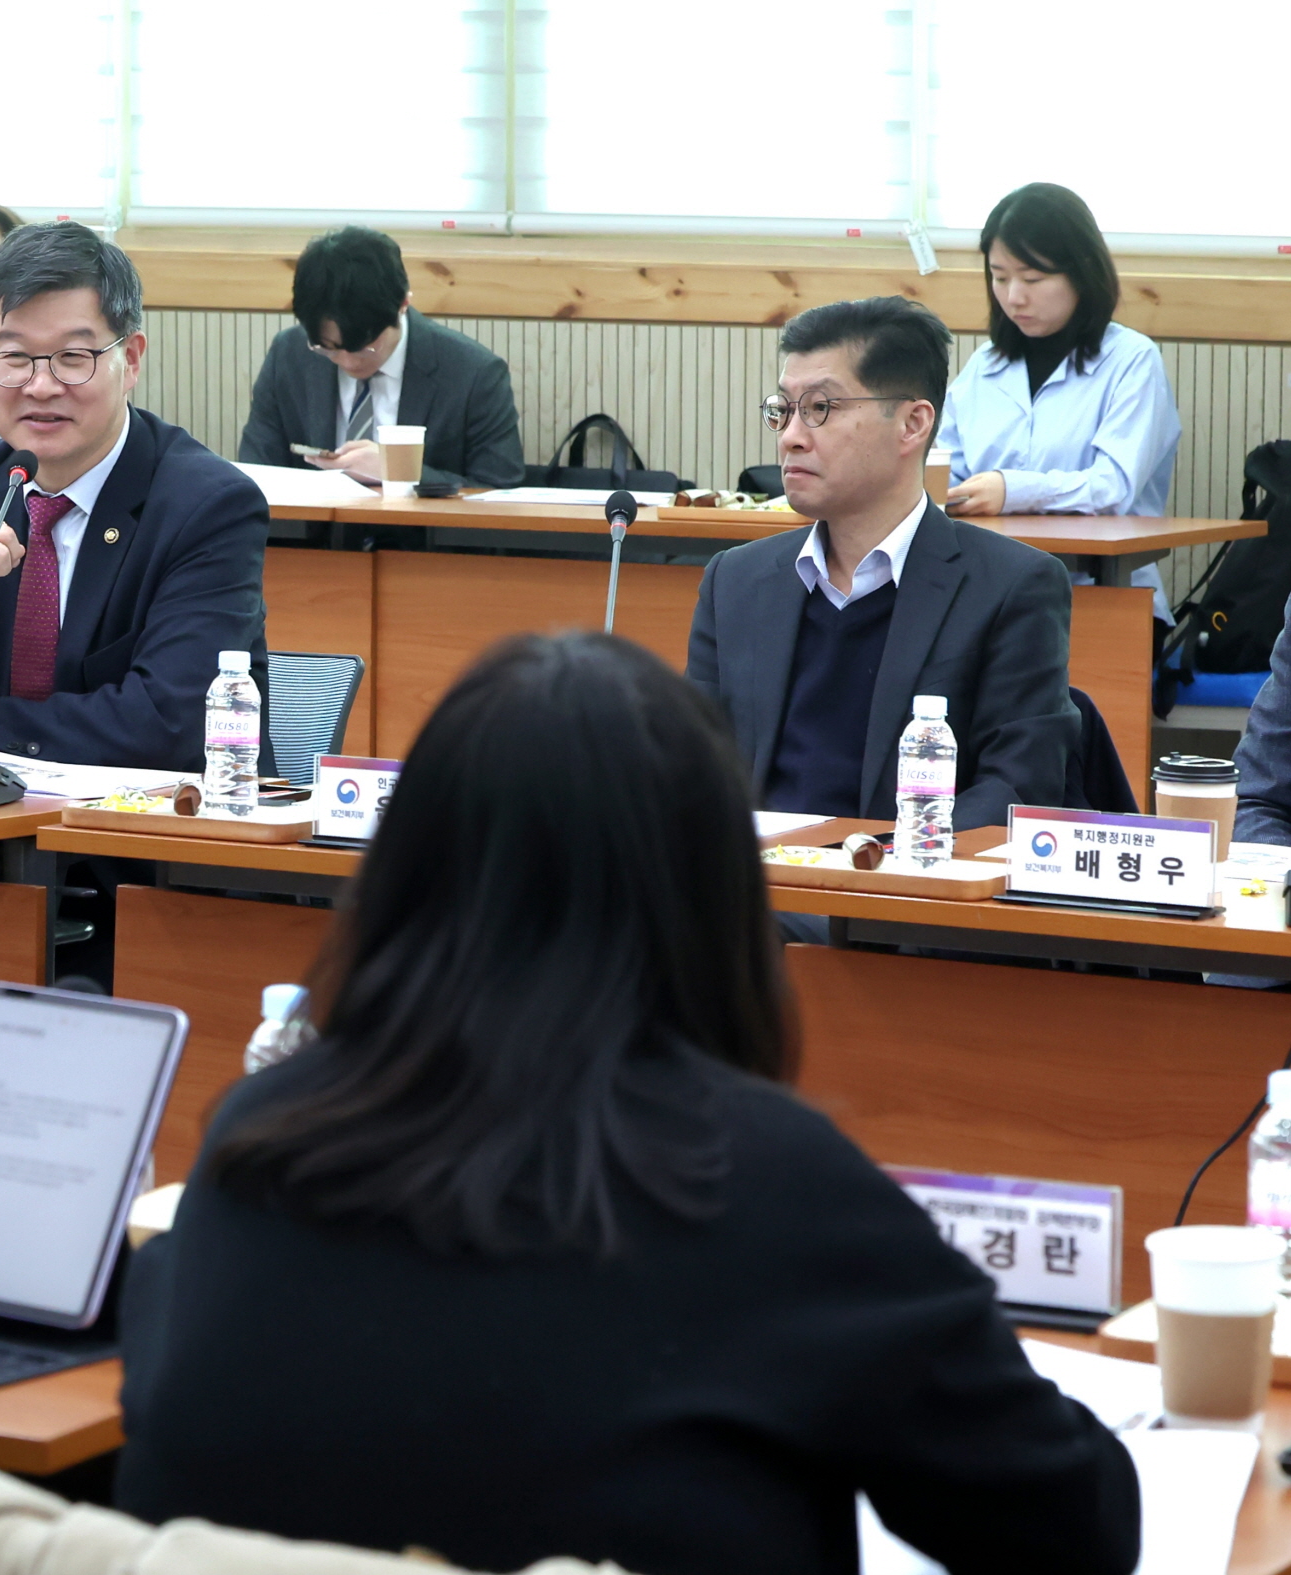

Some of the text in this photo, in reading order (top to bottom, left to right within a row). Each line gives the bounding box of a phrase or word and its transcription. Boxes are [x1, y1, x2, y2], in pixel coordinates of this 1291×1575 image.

[330, 809, 365, 819] 보건복지부
[1073, 828, 1156, 848] 복지행정지원관
[1024, 862, 1062, 874] 보건복지부
